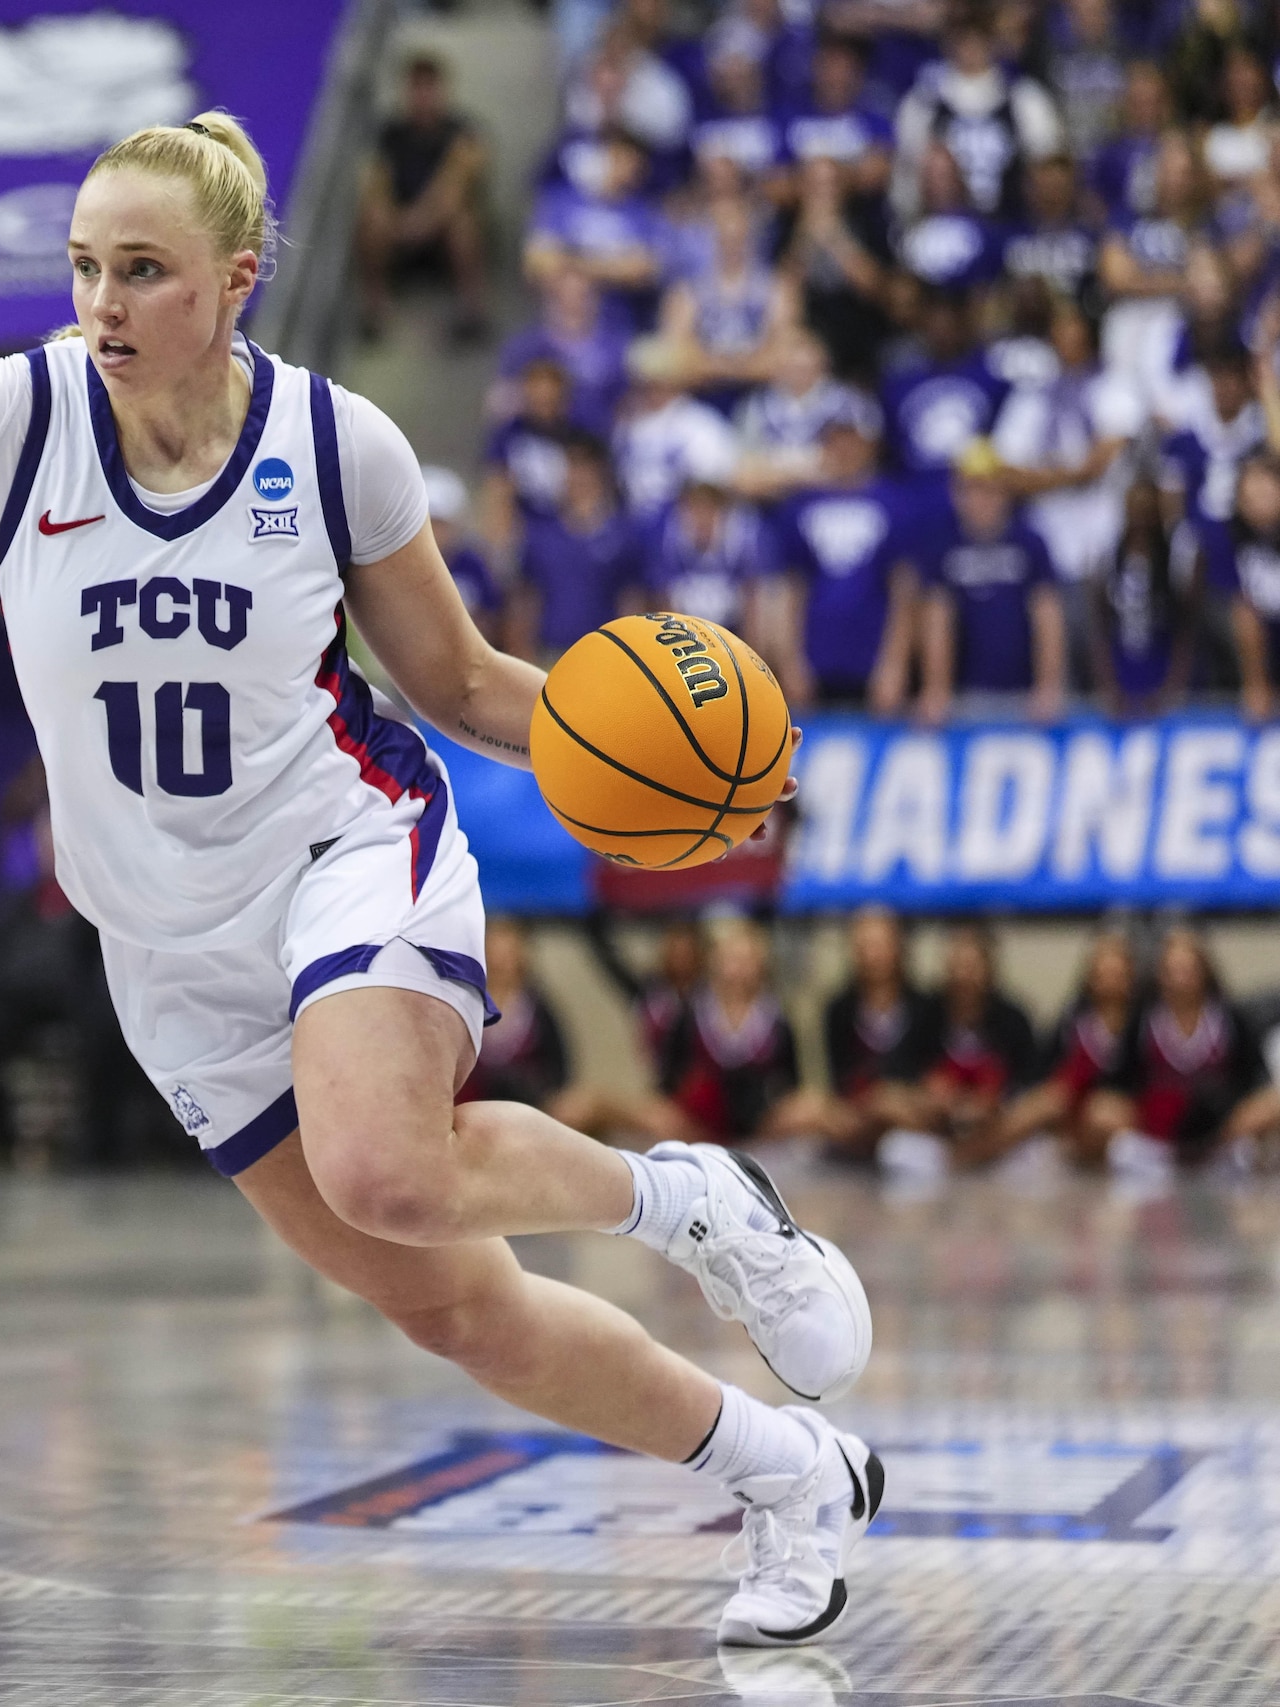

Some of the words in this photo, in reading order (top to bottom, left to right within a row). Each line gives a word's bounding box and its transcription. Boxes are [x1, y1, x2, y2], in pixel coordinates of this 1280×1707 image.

[260, 477, 292, 490] NCAA
[252, 508, 298, 537] XII
[81, 577, 253, 652] TCU
[93, 681, 233, 798] 10
[459, 719, 477, 737] THE
[479, 734, 530, 756] JOURNE
